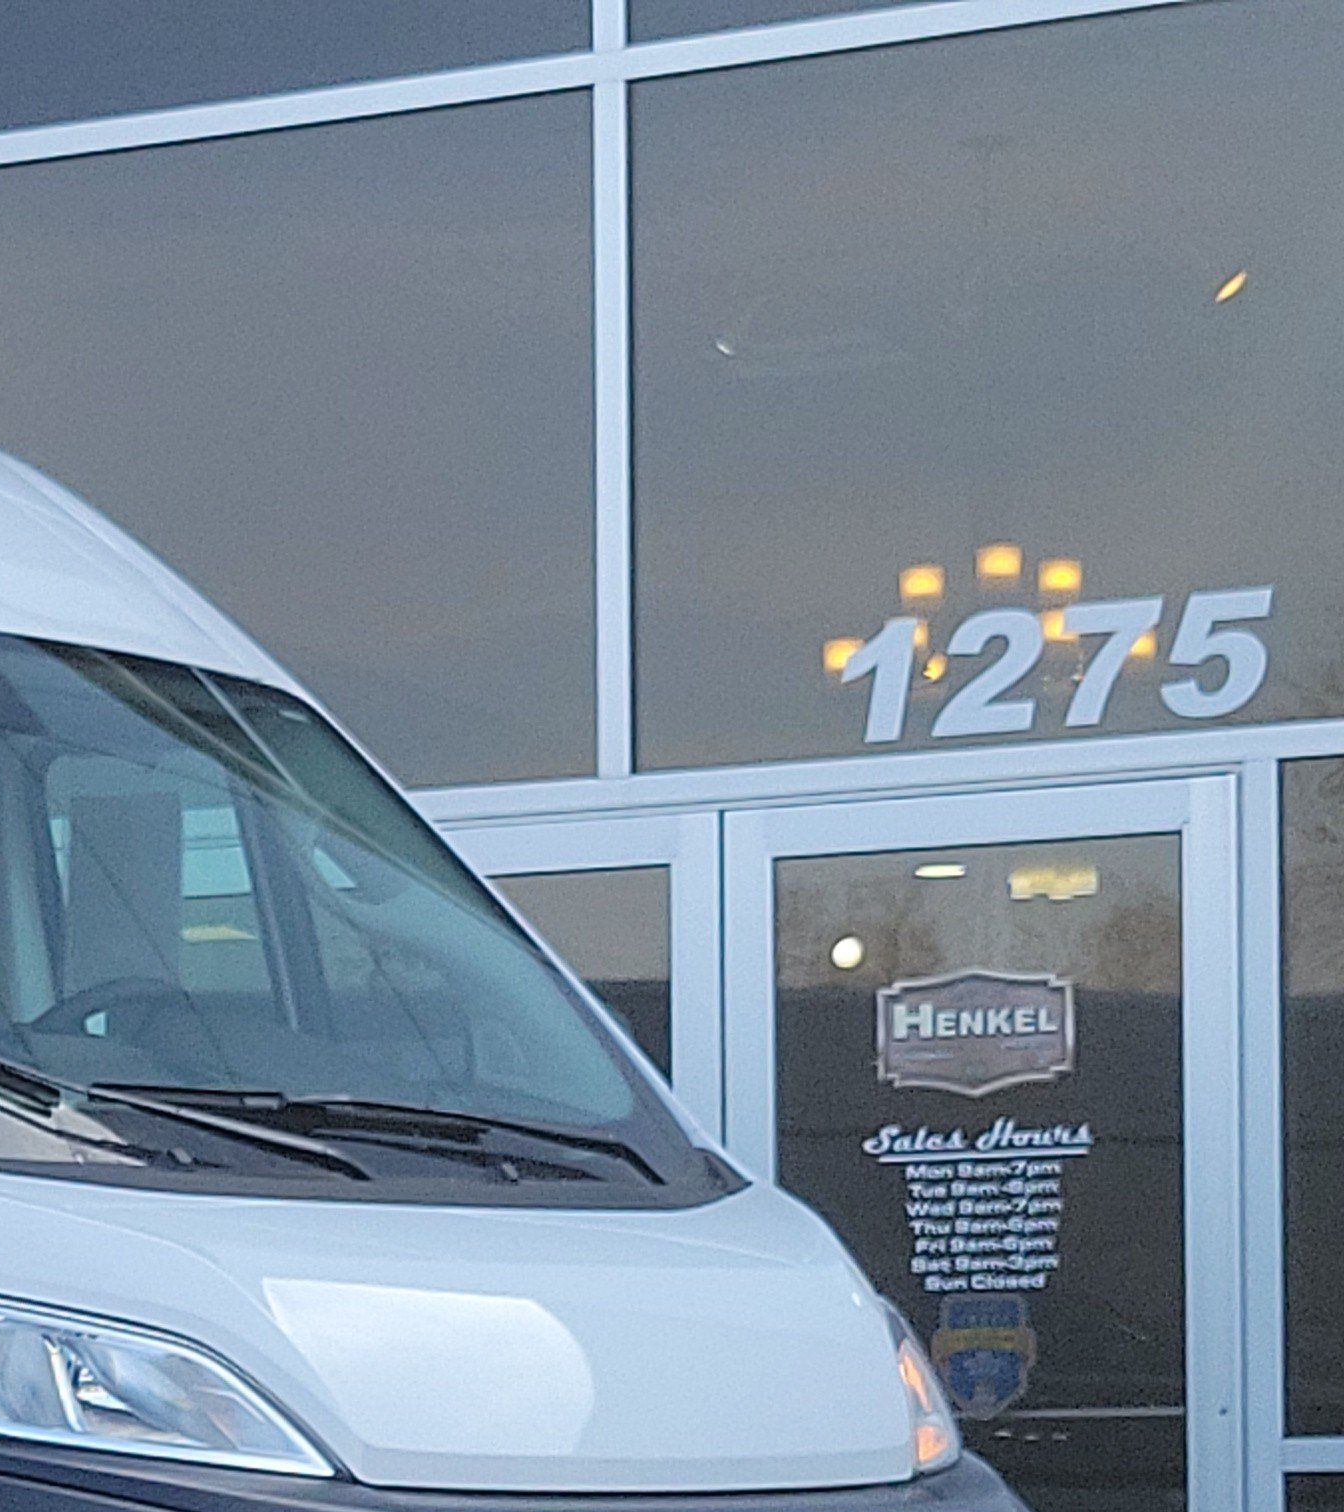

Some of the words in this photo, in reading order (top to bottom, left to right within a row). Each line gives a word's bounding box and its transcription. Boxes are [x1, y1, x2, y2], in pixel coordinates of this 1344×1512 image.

[841, 585, 1275, 744] 1275
[890, 1002, 1059, 1040] HENKEL
[862, 1122, 967, 1155] Sales
[974, 1116, 1094, 1151] Hours
[905, 1163, 954, 1180] Mon
[907, 1181, 948, 1198] Tue
[904, 1199, 955, 1217] Wed
[909, 1218, 952, 1235] Thu
[914, 1236, 947, 1254] Fri
[924, 1274, 967, 1291] Sun
[970, 1272, 1046, 1290] Closed
